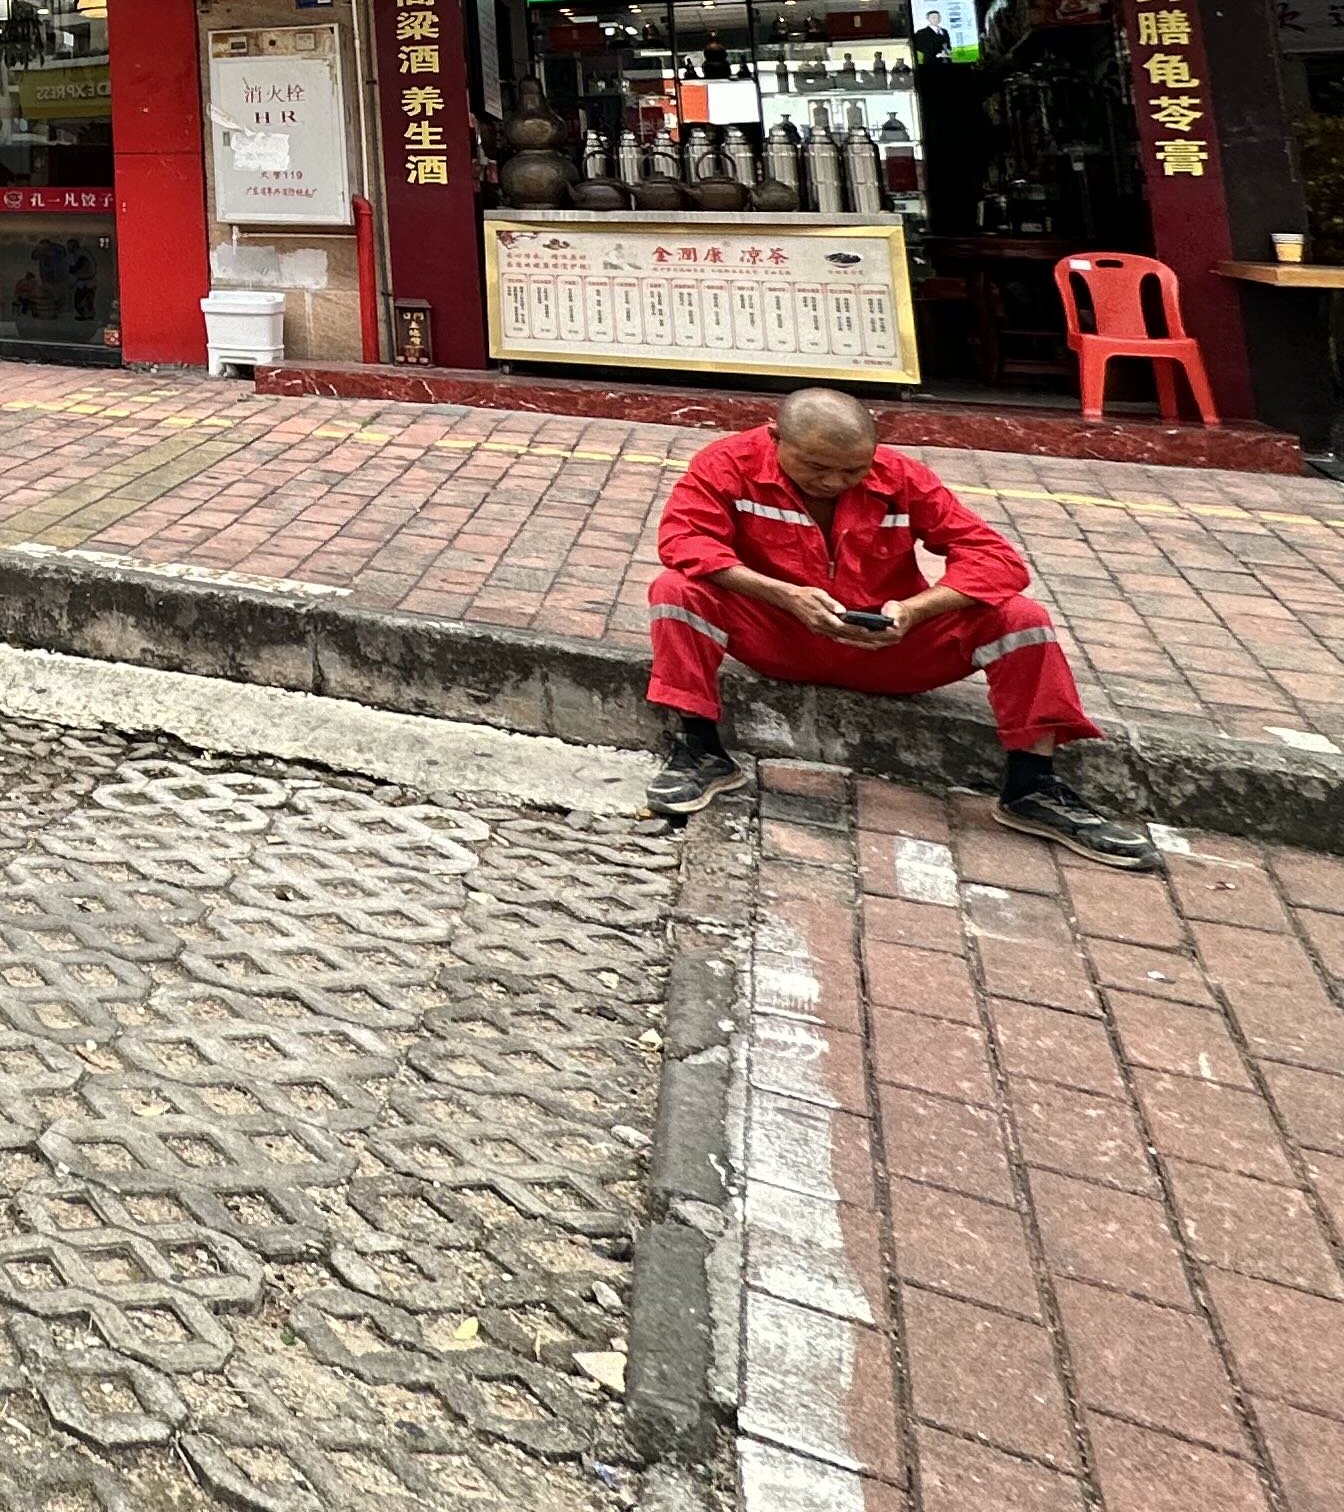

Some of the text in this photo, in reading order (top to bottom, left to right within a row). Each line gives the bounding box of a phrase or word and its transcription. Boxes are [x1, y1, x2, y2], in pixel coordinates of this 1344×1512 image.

[243, 85, 306, 104] 消火栓
[401, 86, 450, 186] 养生酒
[29, 191, 114, 208] 孔一凡饺子
